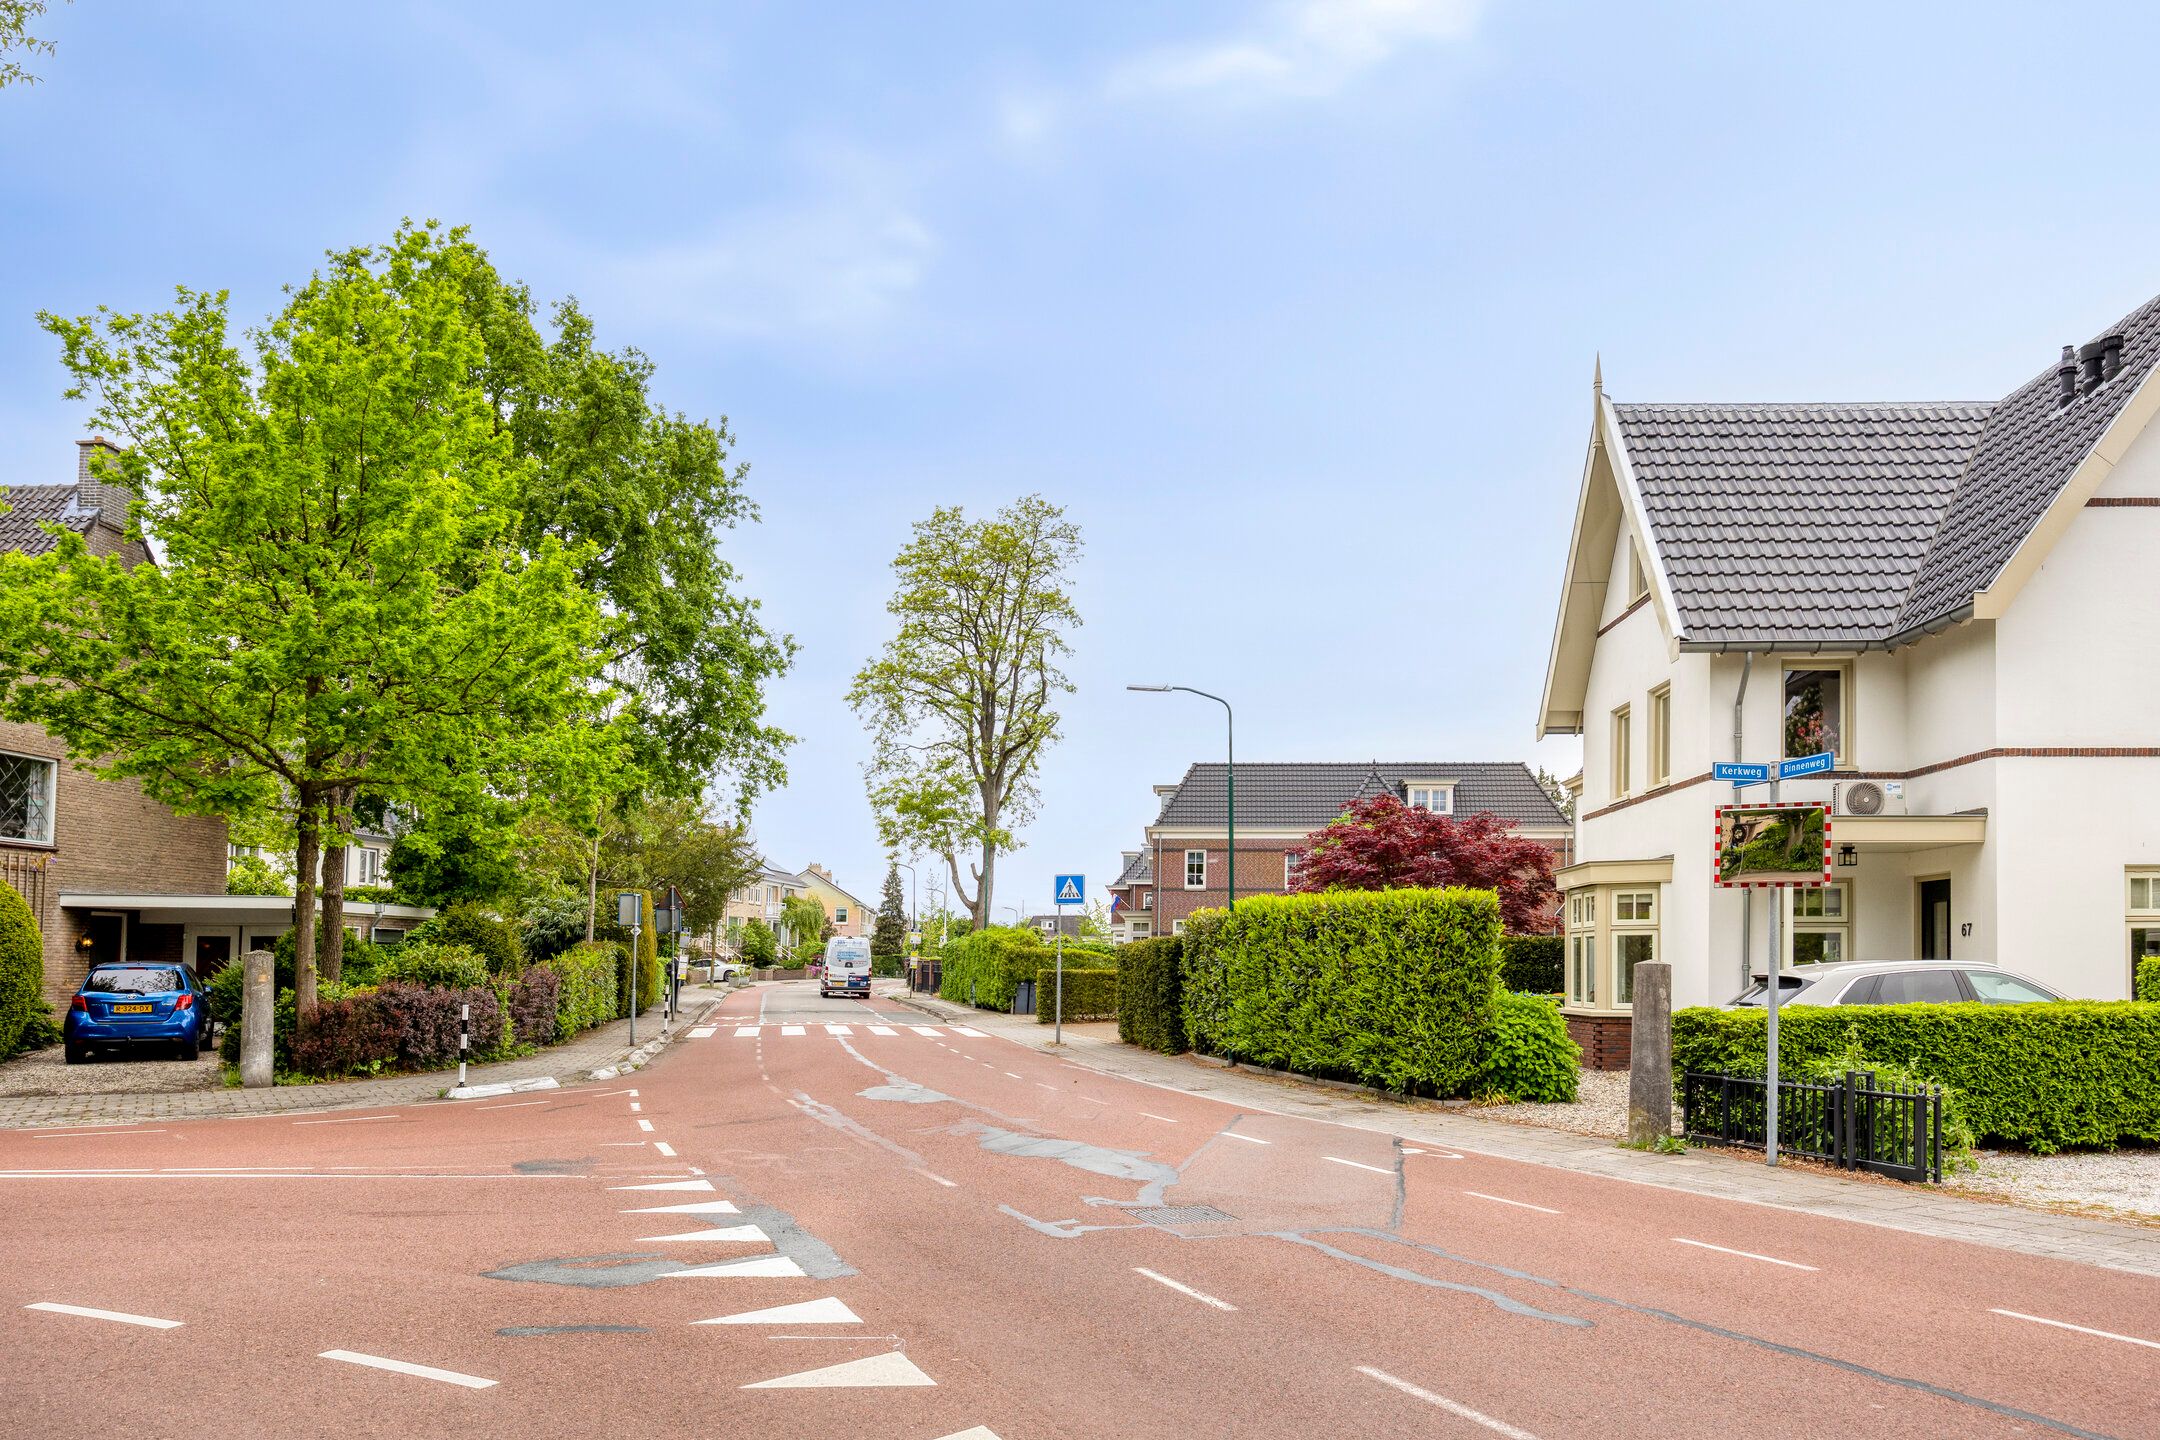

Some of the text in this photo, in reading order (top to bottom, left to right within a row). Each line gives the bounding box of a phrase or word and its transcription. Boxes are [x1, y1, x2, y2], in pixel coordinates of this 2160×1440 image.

[1722, 766, 1762, 777] Kerkweg
[1784, 758, 1825, 773] Binnenweg
[1961, 923, 1972, 936] 67
